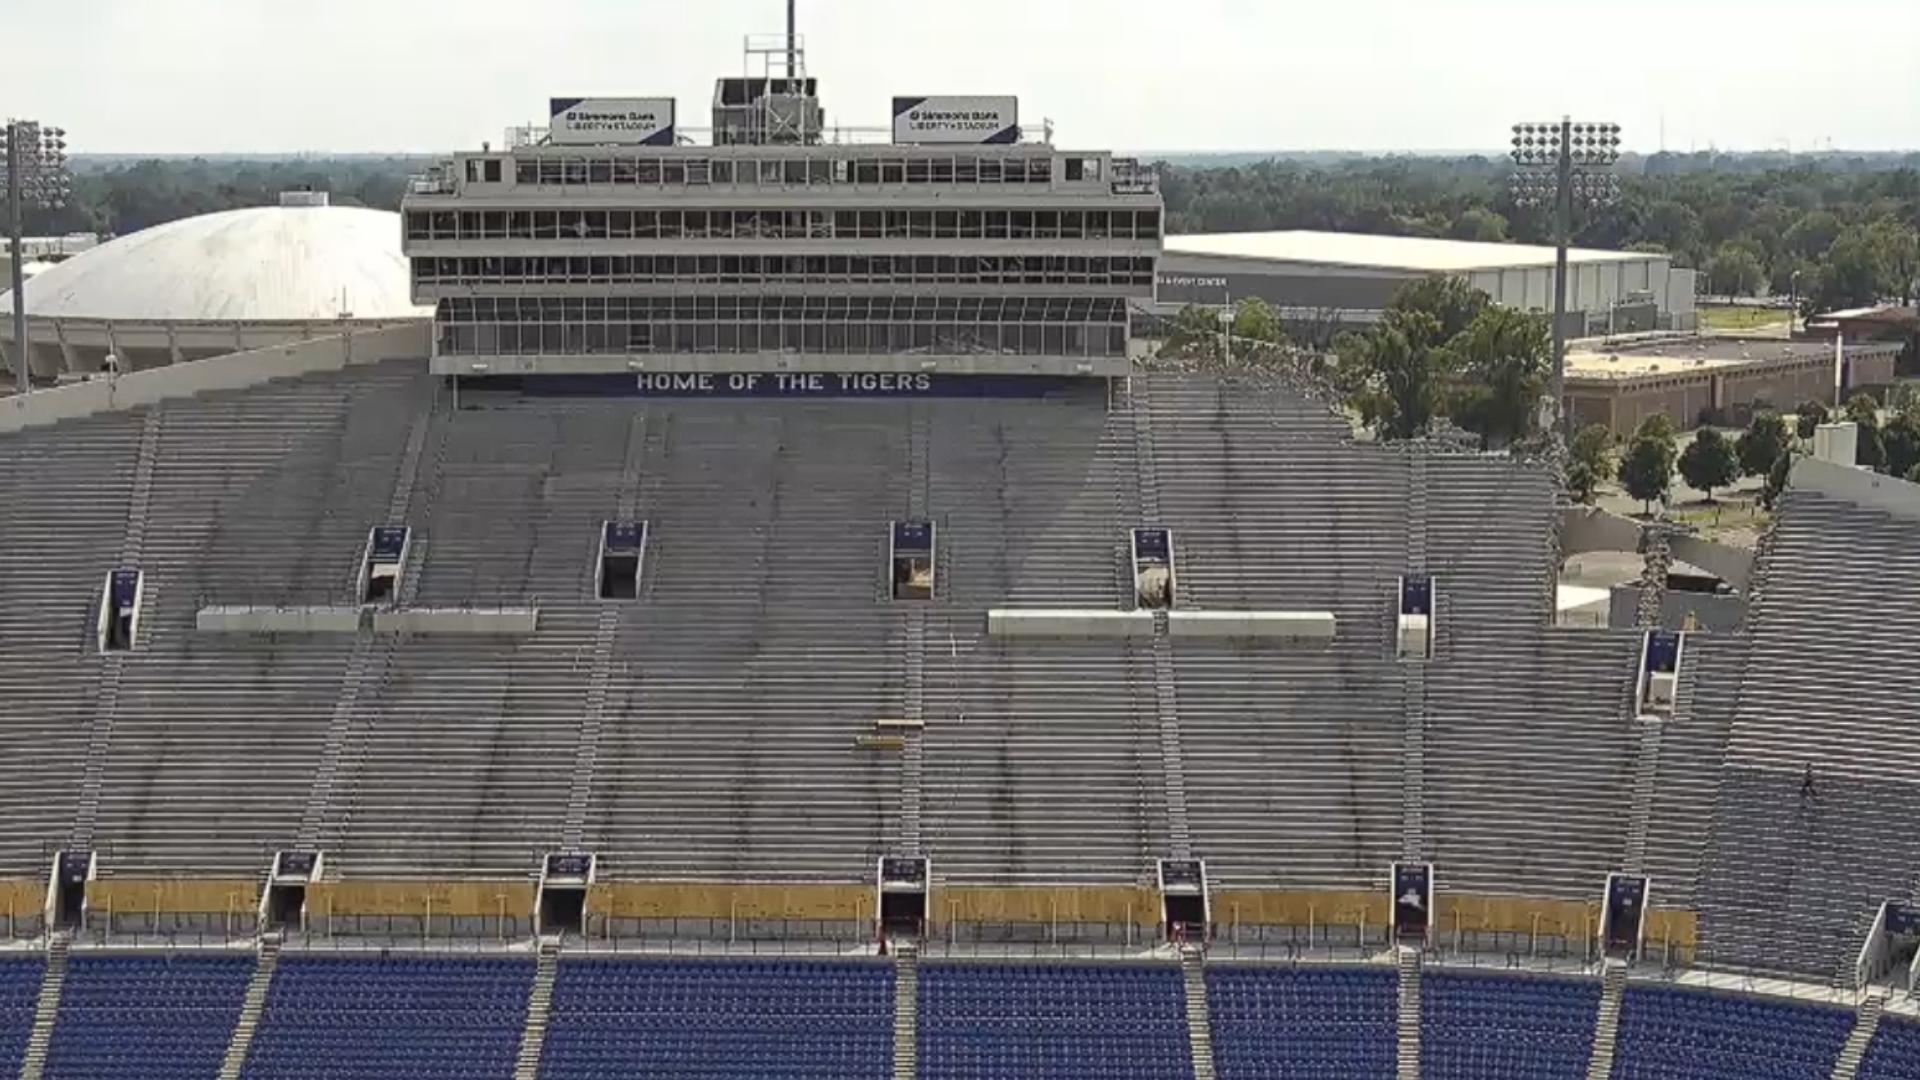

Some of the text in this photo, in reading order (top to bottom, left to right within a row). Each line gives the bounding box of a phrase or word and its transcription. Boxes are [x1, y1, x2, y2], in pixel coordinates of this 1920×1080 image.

[636, 373, 931, 390] HOME OF THE TIGERS
